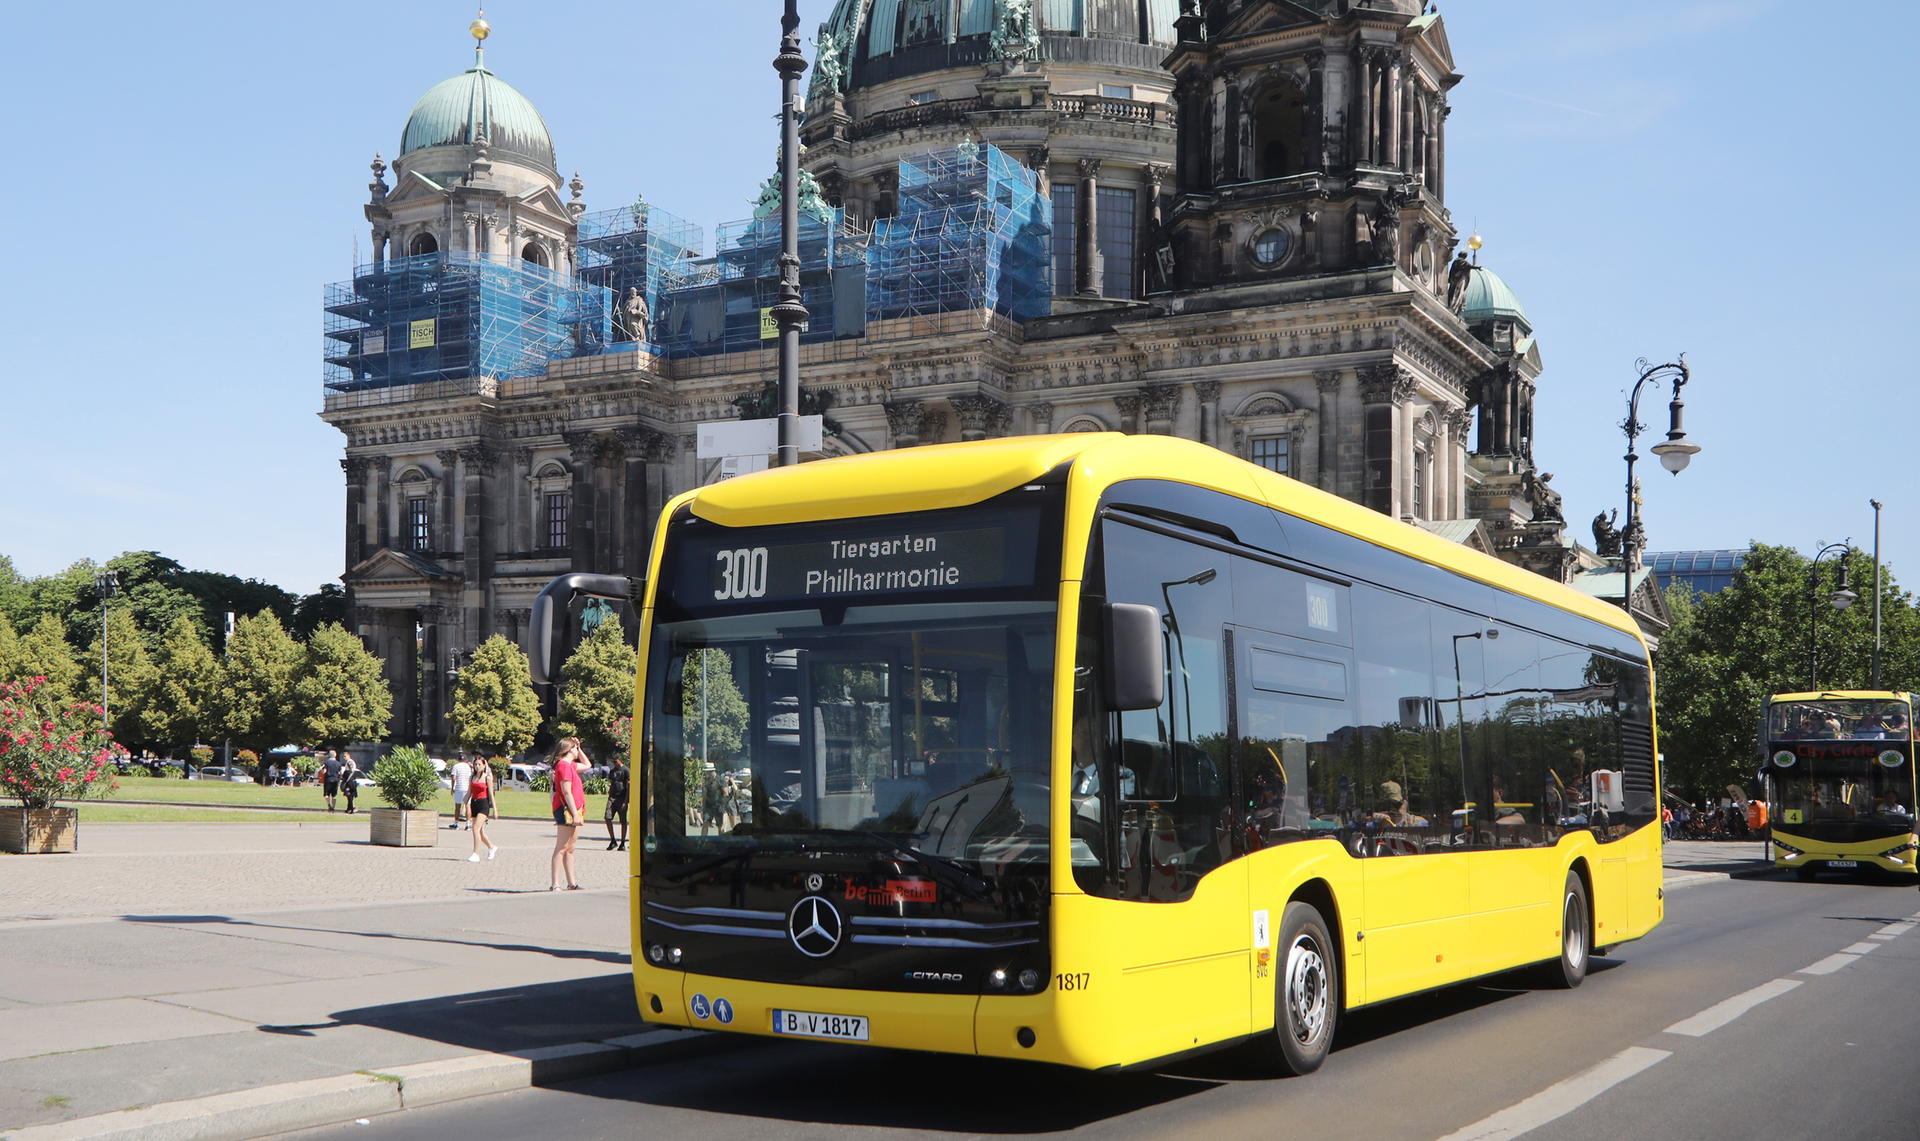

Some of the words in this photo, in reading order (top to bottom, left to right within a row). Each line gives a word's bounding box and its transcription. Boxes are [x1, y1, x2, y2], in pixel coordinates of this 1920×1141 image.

[412, 328, 434, 338] TISCH
[831, 534, 937, 560] Tiergarten
[714, 547, 769, 601] 300
[805, 561, 960, 595] Philharmonie
[1309, 595, 1329, 627] 300
[1790, 812, 1798, 822] 4
[844, 879, 867, 900] be
[895, 885, 931, 898] Berlin
[1055, 972, 1090, 991] 1817
[787, 1013, 798, 1031] B
[807, 1015, 818, 1033] V
[822, 1016, 861, 1037] 1817
